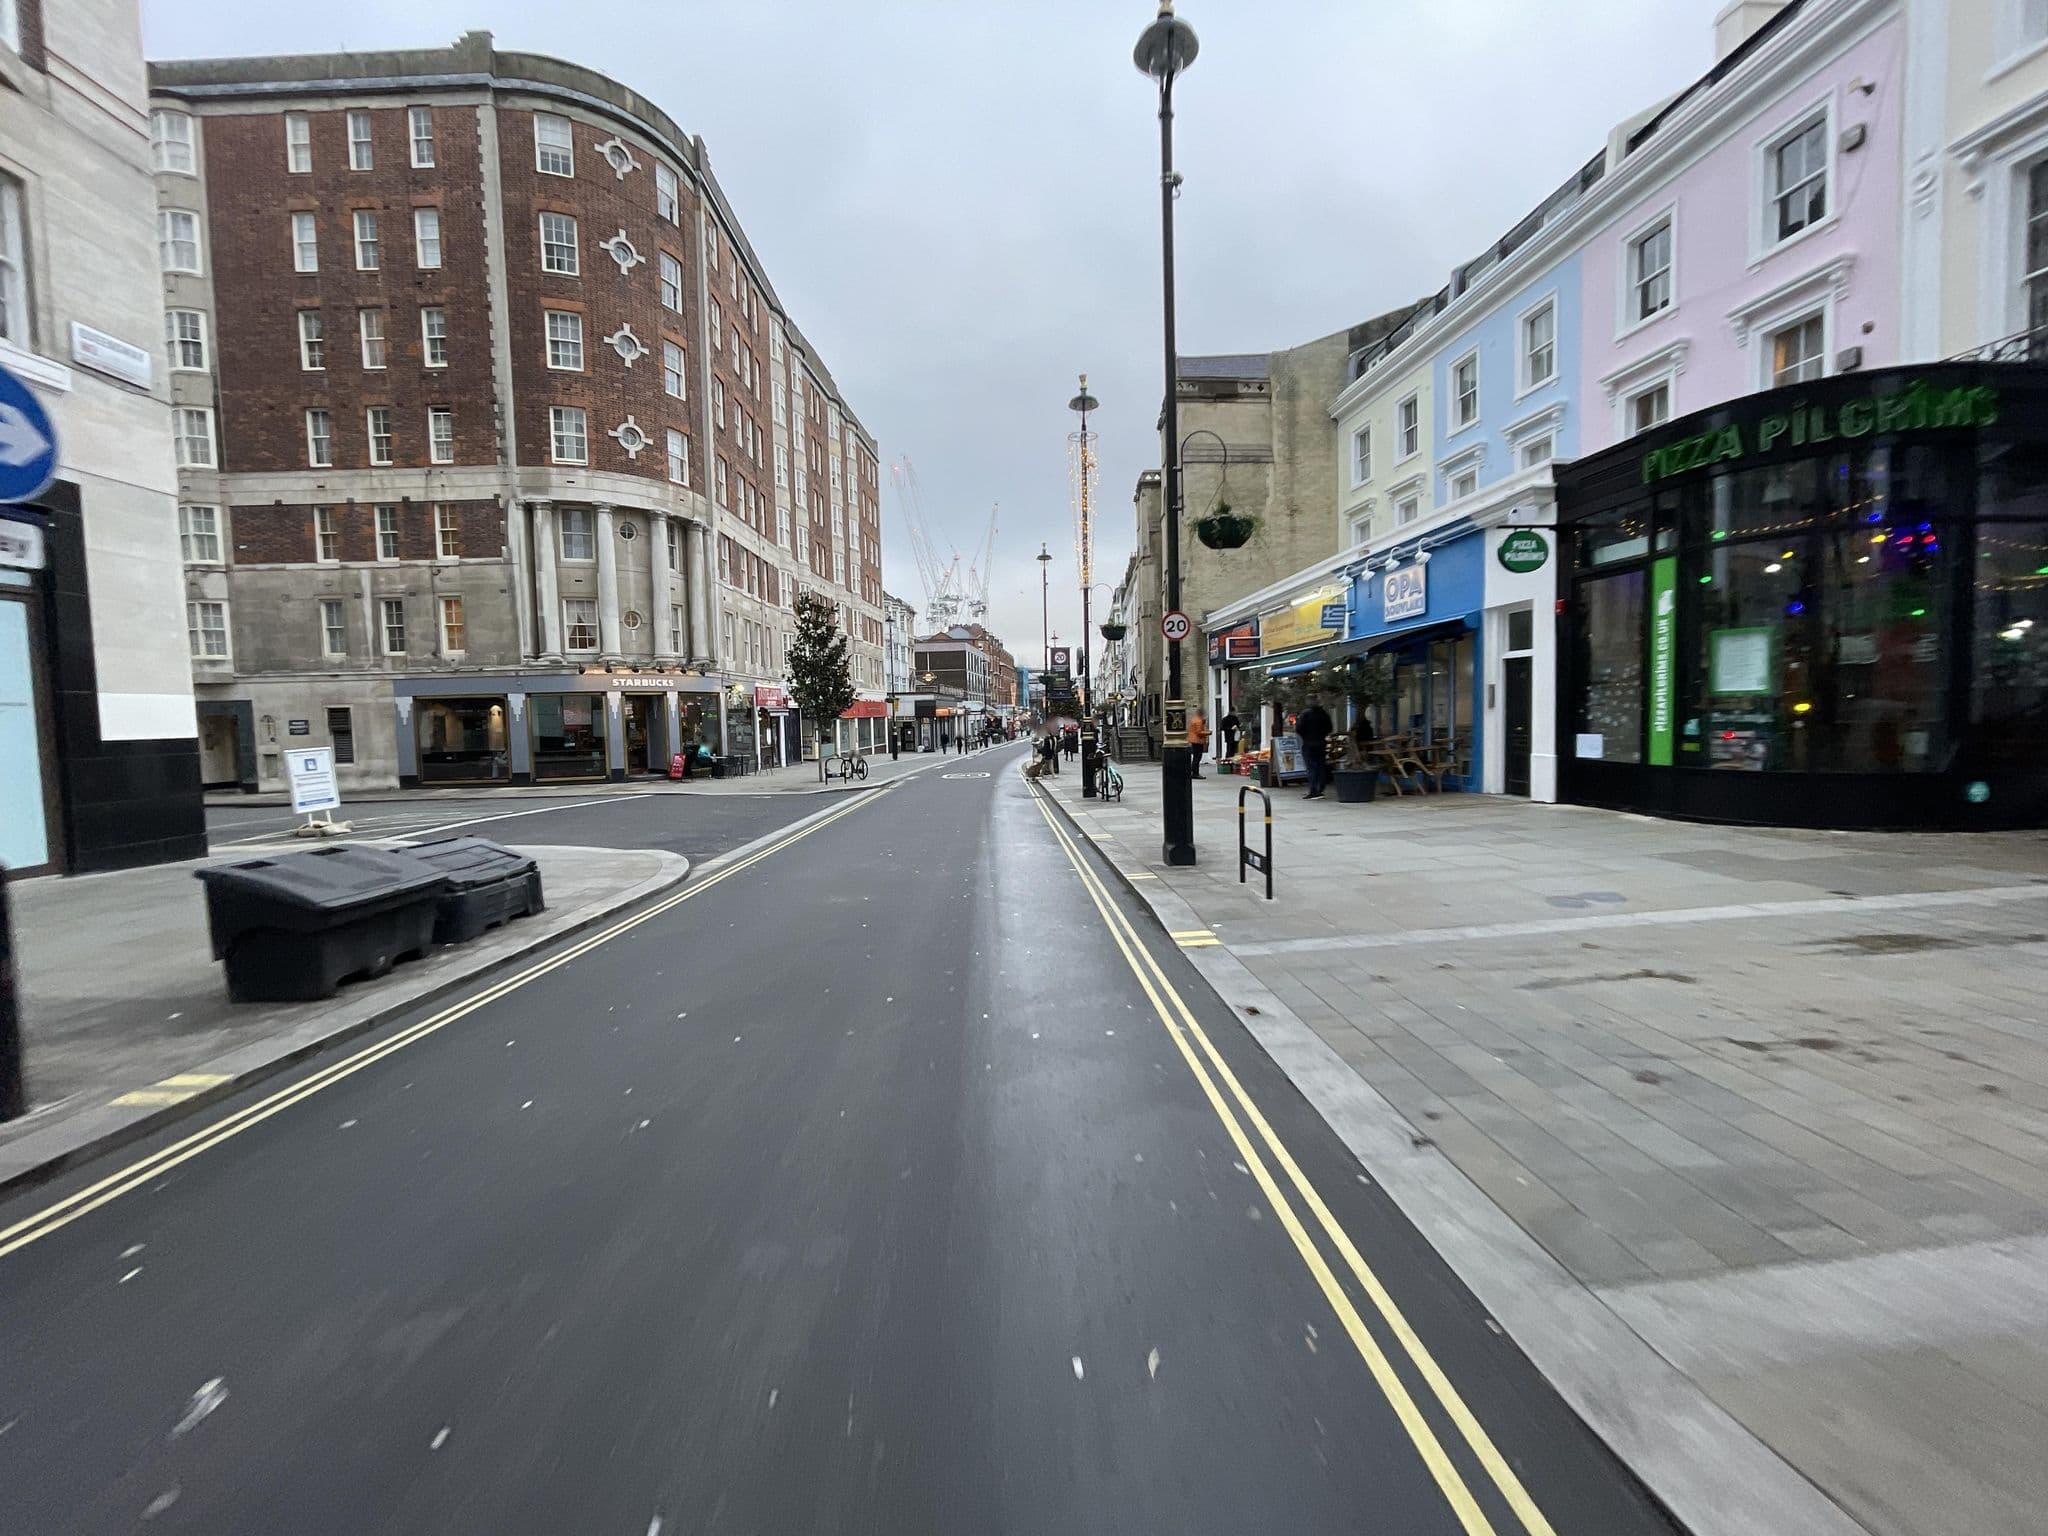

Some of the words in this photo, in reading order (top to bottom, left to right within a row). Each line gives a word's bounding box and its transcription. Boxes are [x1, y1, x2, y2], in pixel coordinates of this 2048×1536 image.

[1642, 422, 1743, 486] PIZZA
[1386, 571, 1422, 603] OPA
[1166, 620, 1187, 633] 20
[612, 678, 674, 687] STARBUCKS
